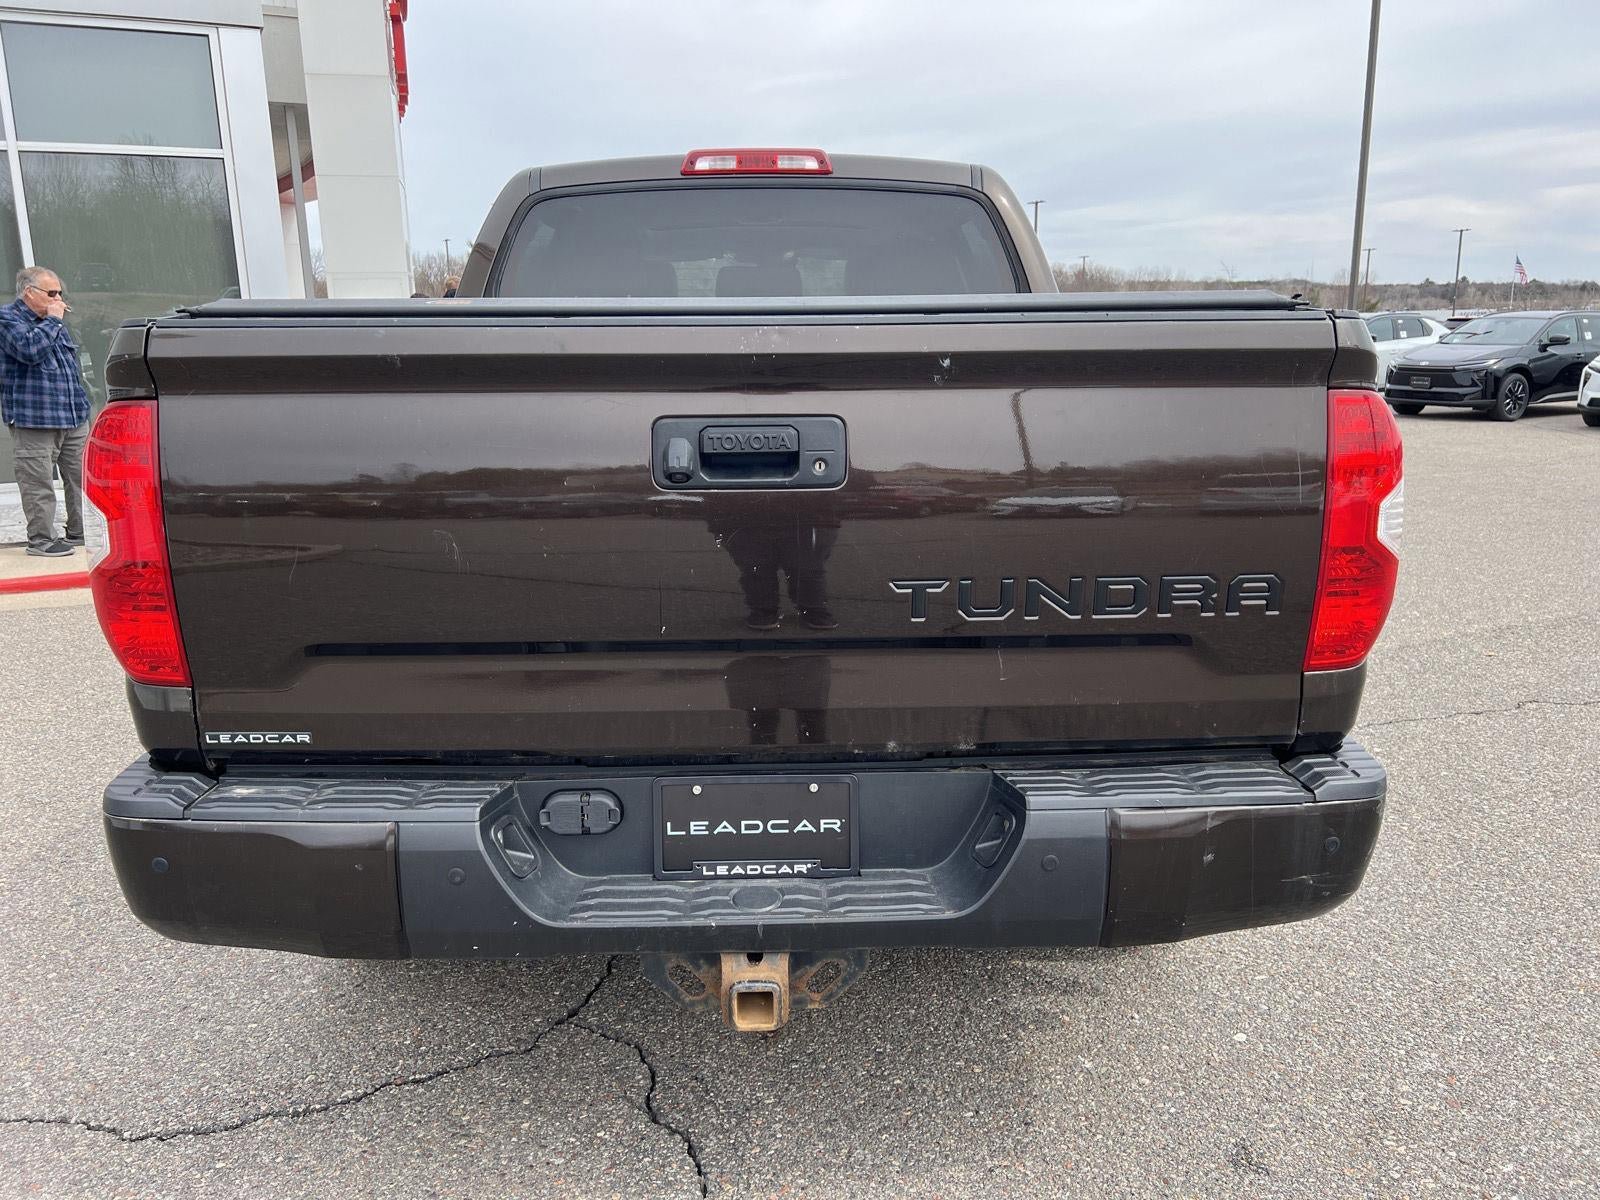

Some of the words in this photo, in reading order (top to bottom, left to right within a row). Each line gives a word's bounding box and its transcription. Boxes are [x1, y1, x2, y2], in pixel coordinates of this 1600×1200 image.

[707, 431, 792, 451] TOYOTA
[889, 573, 1280, 622] TUNDRA
[205, 734, 311, 744] LEADCAR
[666, 818, 845, 836] LEADCAR
[702, 863, 812, 876] LEADCAR
